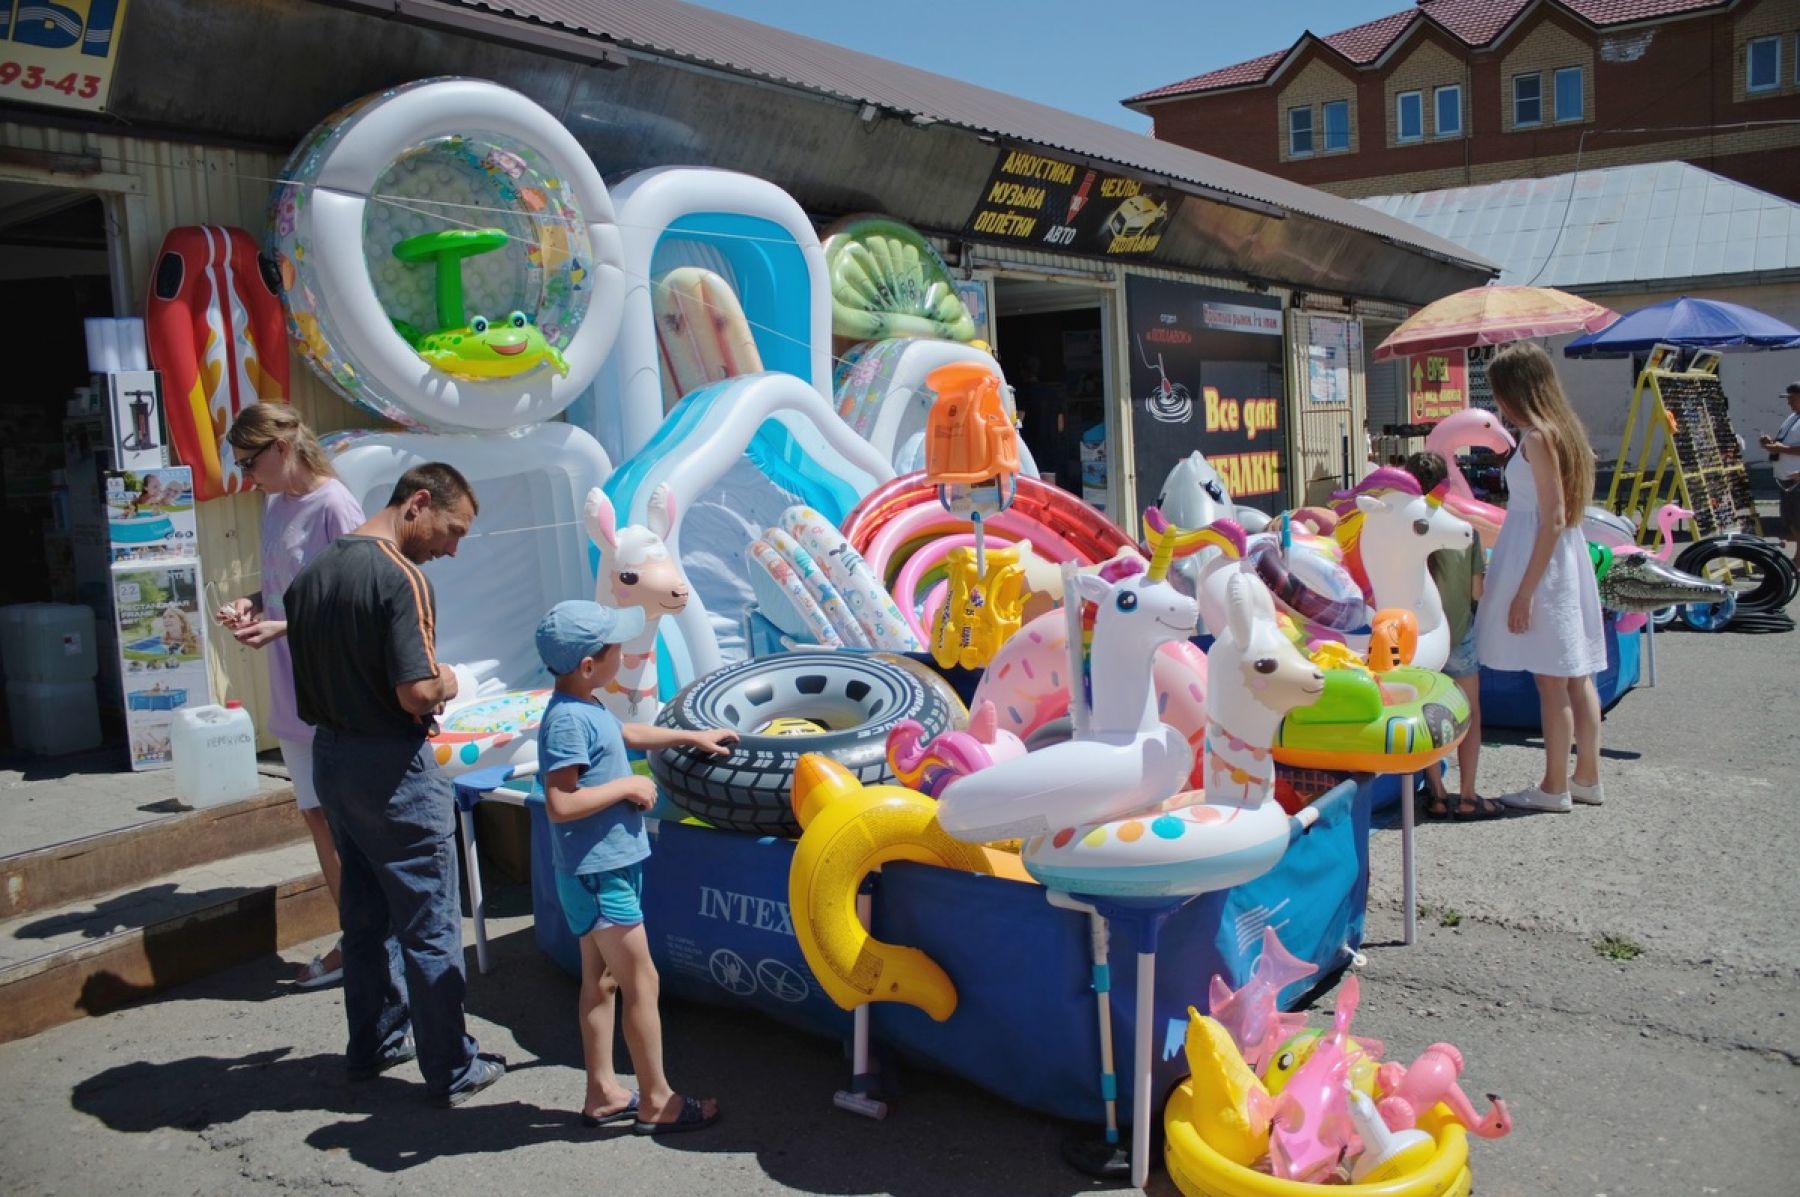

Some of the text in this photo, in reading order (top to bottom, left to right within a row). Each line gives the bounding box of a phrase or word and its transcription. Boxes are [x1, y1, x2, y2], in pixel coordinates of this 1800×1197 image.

[988, 181, 1046, 210] МУЗЫКА
[1043, 225, 1077, 245] АВТО
[1203, 386, 1278, 440] Все для
[697, 886, 796, 937] INTEX
